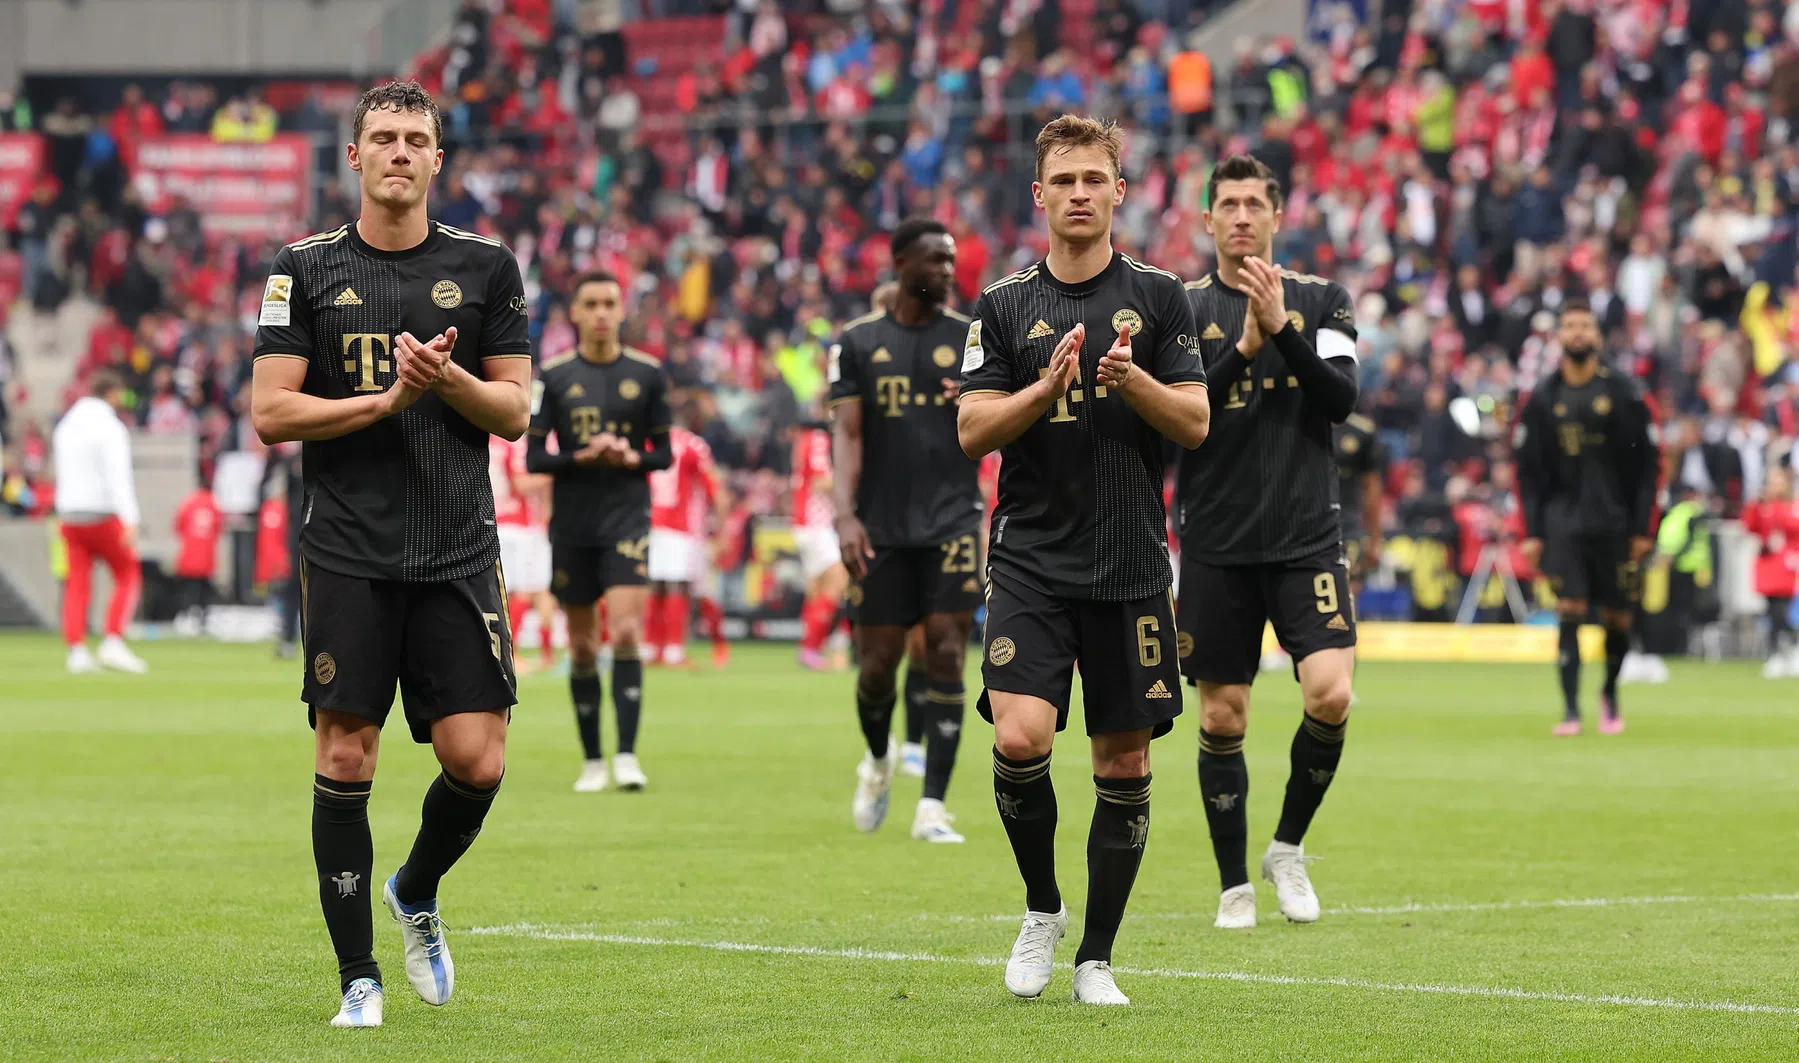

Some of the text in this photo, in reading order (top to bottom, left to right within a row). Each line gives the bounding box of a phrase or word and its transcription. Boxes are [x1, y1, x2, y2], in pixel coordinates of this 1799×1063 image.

[343, 333, 390, 391] T
[940, 535, 977, 573] 23
[1313, 571, 1339, 614] 9
[482, 612, 502, 661] 5
[1136, 615, 1162, 667] 6
[1145, 691, 1172, 699] adidas
